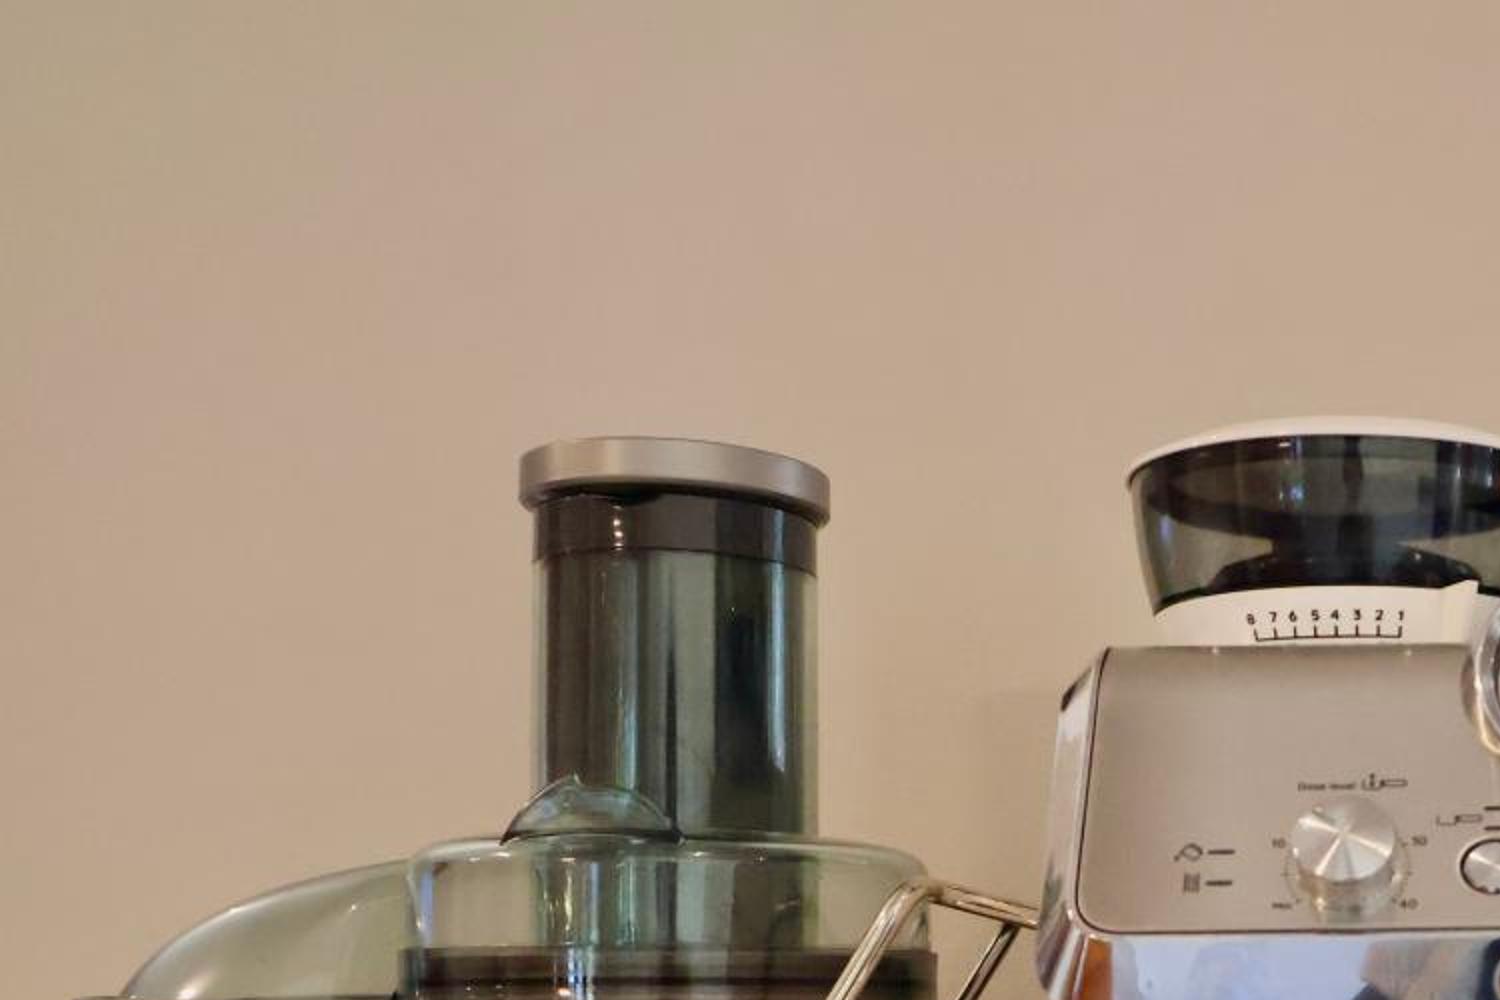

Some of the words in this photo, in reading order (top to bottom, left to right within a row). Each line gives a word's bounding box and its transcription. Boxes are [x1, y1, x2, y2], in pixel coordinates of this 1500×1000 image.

[1246, 613, 1256, 625] 8
[1269, 611, 1277, 623] 7
[1289, 610, 1297, 622] 6
[1312, 609, 1320, 621] 5
[1331, 609, 1339, 621] 4
[1354, 609, 1361, 621] 3
[1375, 609, 1384, 621] 2
[1398, 610, 1404, 621] 1
